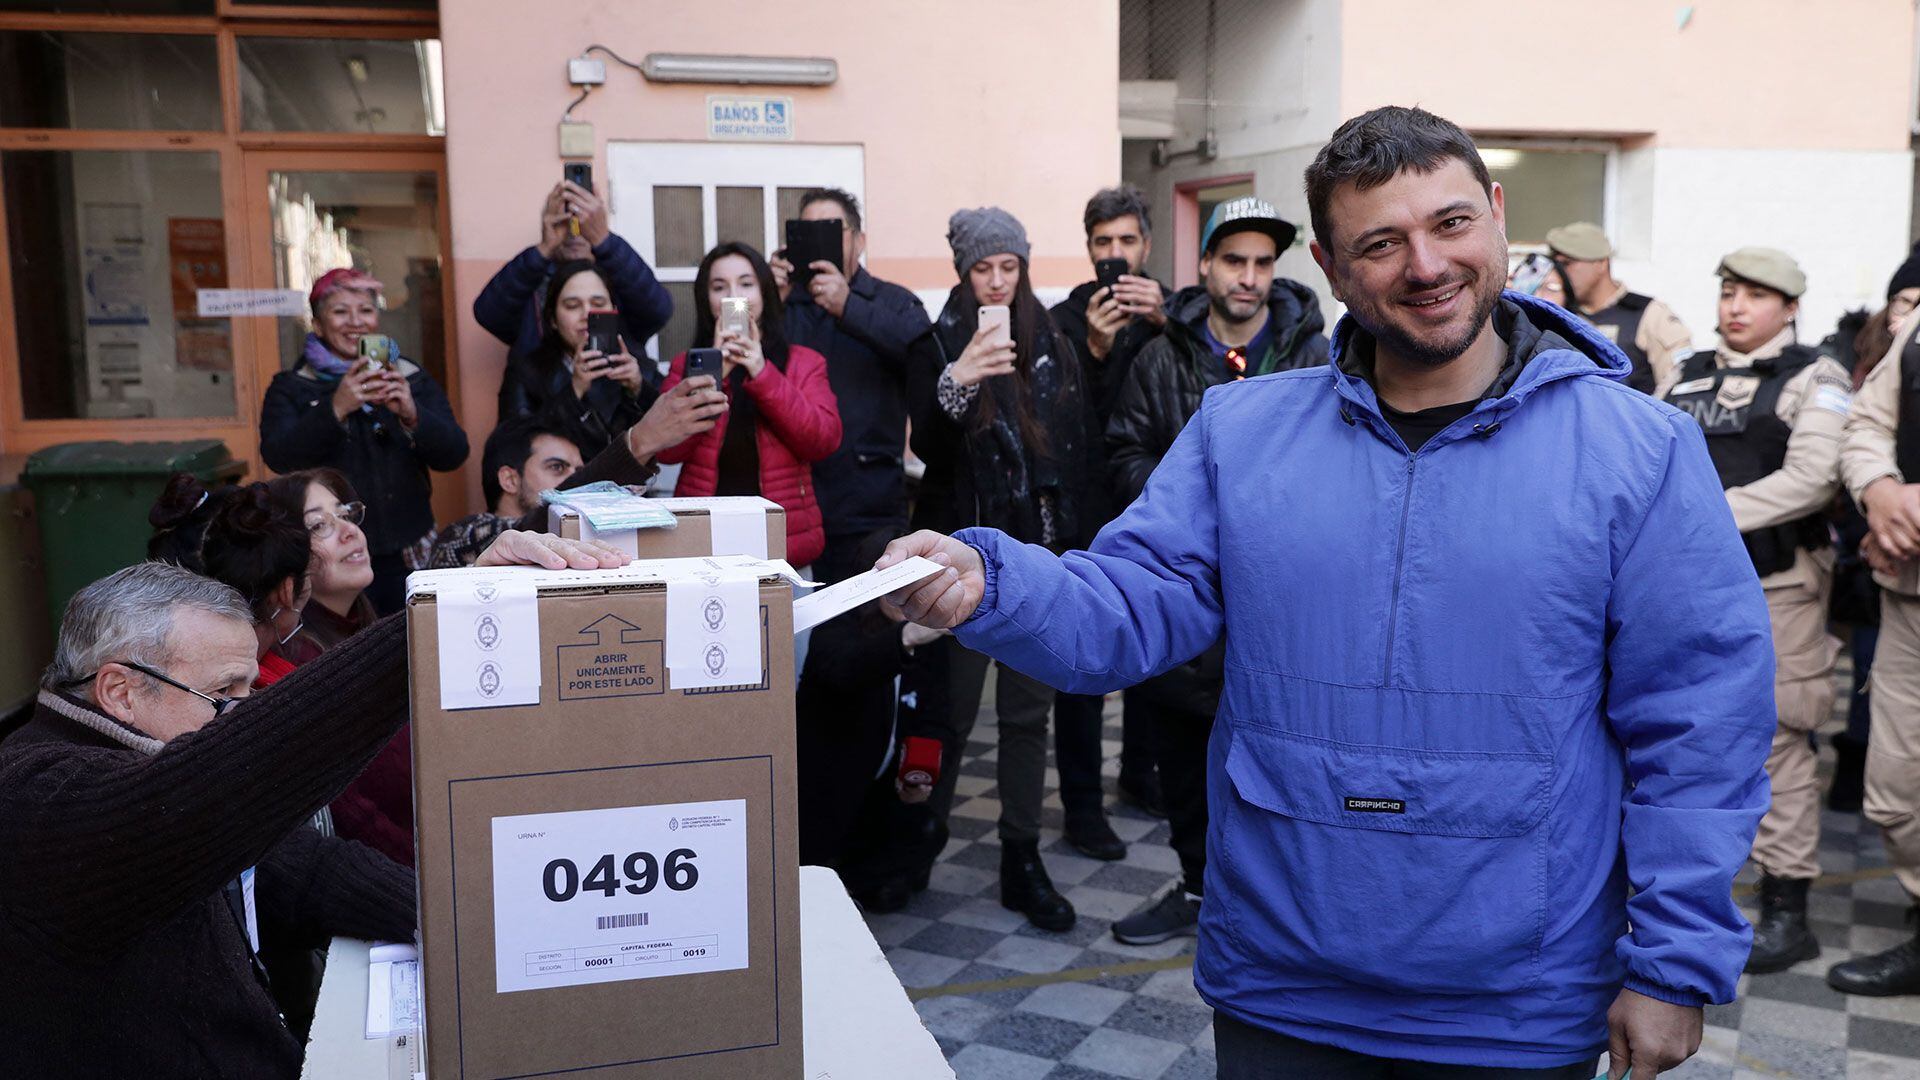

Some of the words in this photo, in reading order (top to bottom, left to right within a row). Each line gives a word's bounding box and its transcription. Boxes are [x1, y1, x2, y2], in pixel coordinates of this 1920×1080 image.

[714, 102, 759, 121] BAÑOS
[594, 653, 628, 664] ABRIR
[576, 665, 646, 677] UNICAMENTE
[569, 681, 592, 690] POR
[594, 678, 621, 689] ESTE
[624, 676, 654, 687] LADO
[517, 832, 538, 840] URNA
[542, 848, 699, 902] 0496
[646, 941, 673, 949] FEDERAL
[585, 957, 614, 967] 00001
[683, 948, 706, 958] 0019
